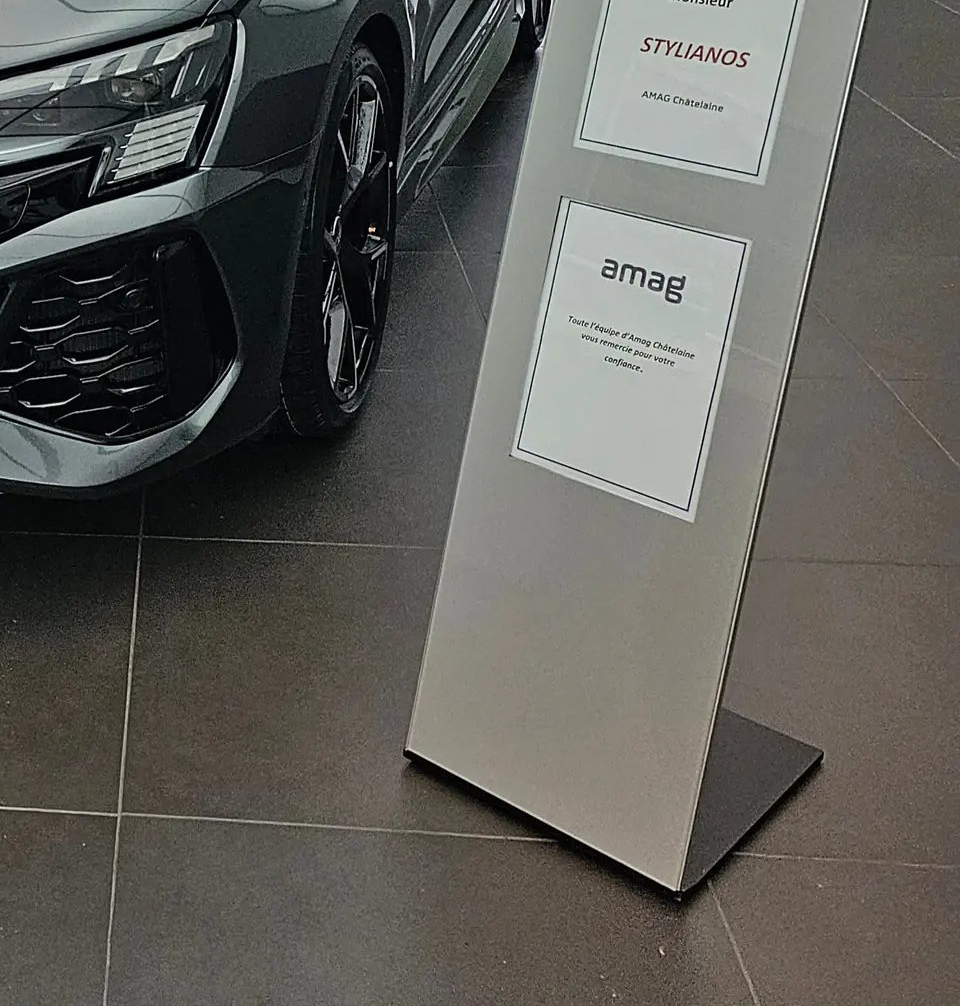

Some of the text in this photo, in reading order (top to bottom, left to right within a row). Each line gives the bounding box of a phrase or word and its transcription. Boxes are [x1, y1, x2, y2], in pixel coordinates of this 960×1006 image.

[640, 36, 751, 69] STYLIANOS
[641, 90, 724, 113] AMAG Châtelaine
[600, 258, 688, 305] amag
[568, 315, 696, 360] Toute l'équipe d'Amag Châtelaine
[581, 333, 676, 367] vous remercie pour votre
[604, 355, 644, 373] confiance.
